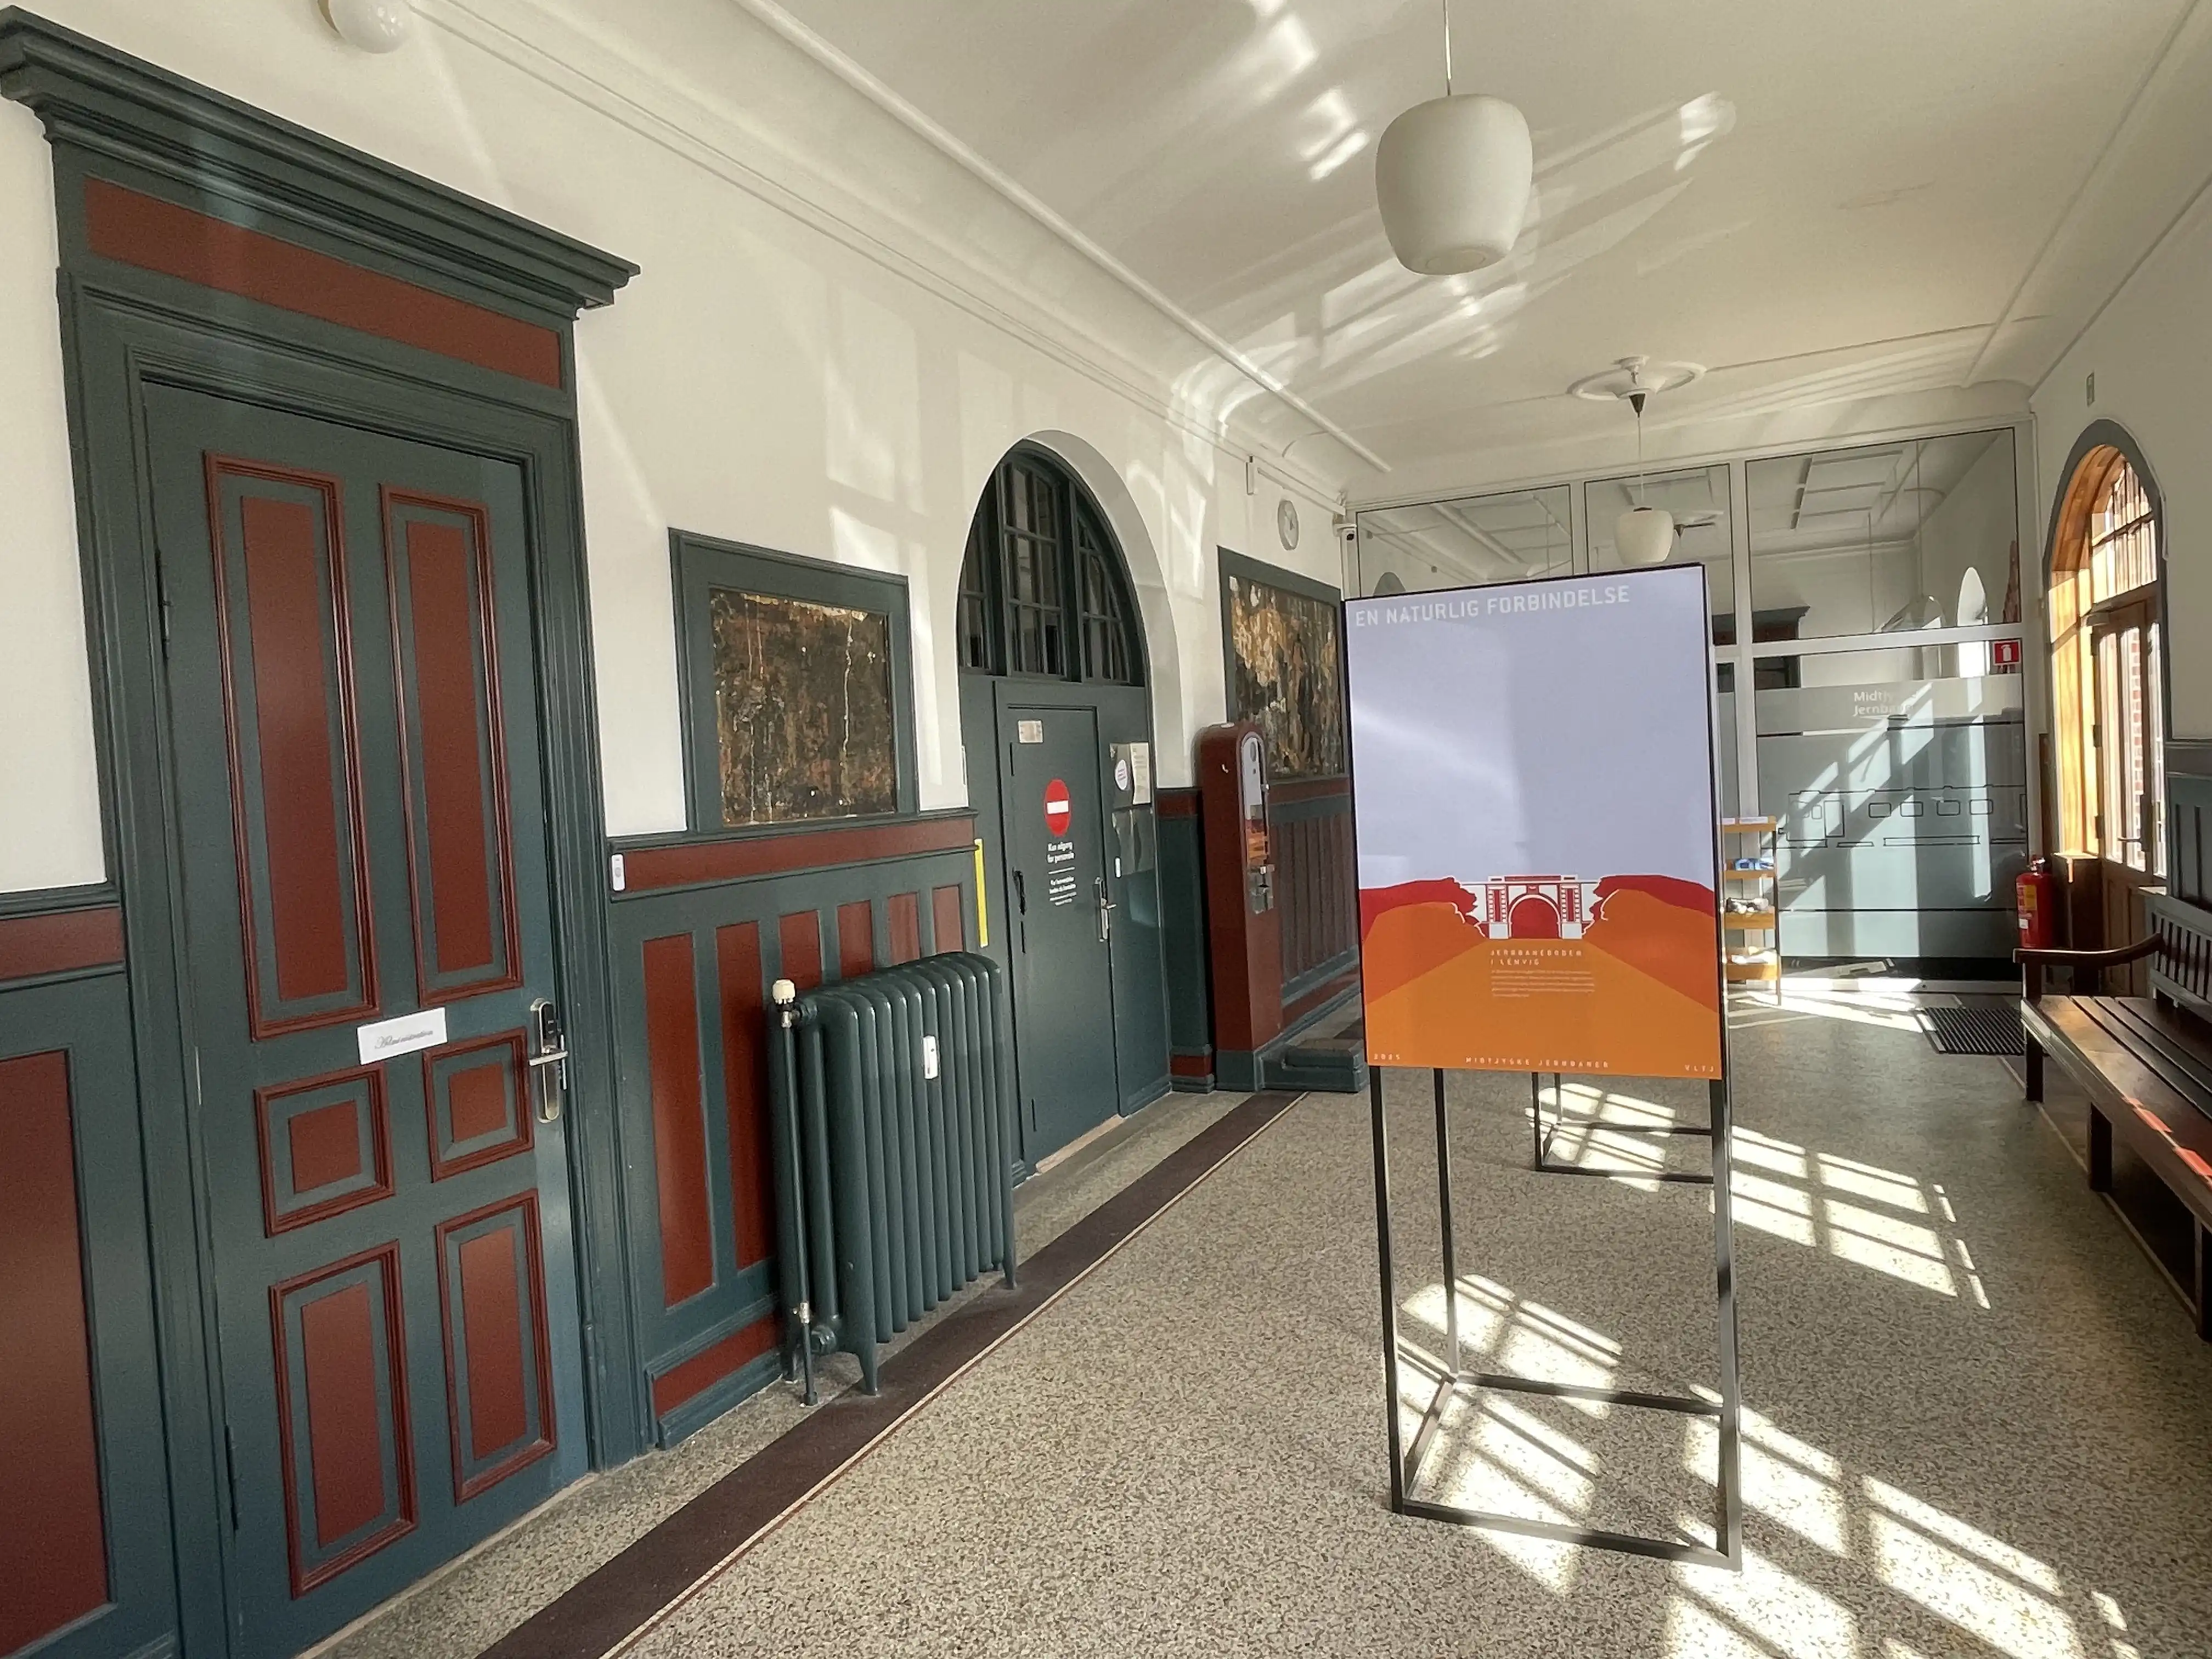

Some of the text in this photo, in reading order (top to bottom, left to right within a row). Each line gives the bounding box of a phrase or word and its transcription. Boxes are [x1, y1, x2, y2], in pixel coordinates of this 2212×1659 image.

[1356, 585, 1630, 627] EN NATURLIG FORBINDELSE
